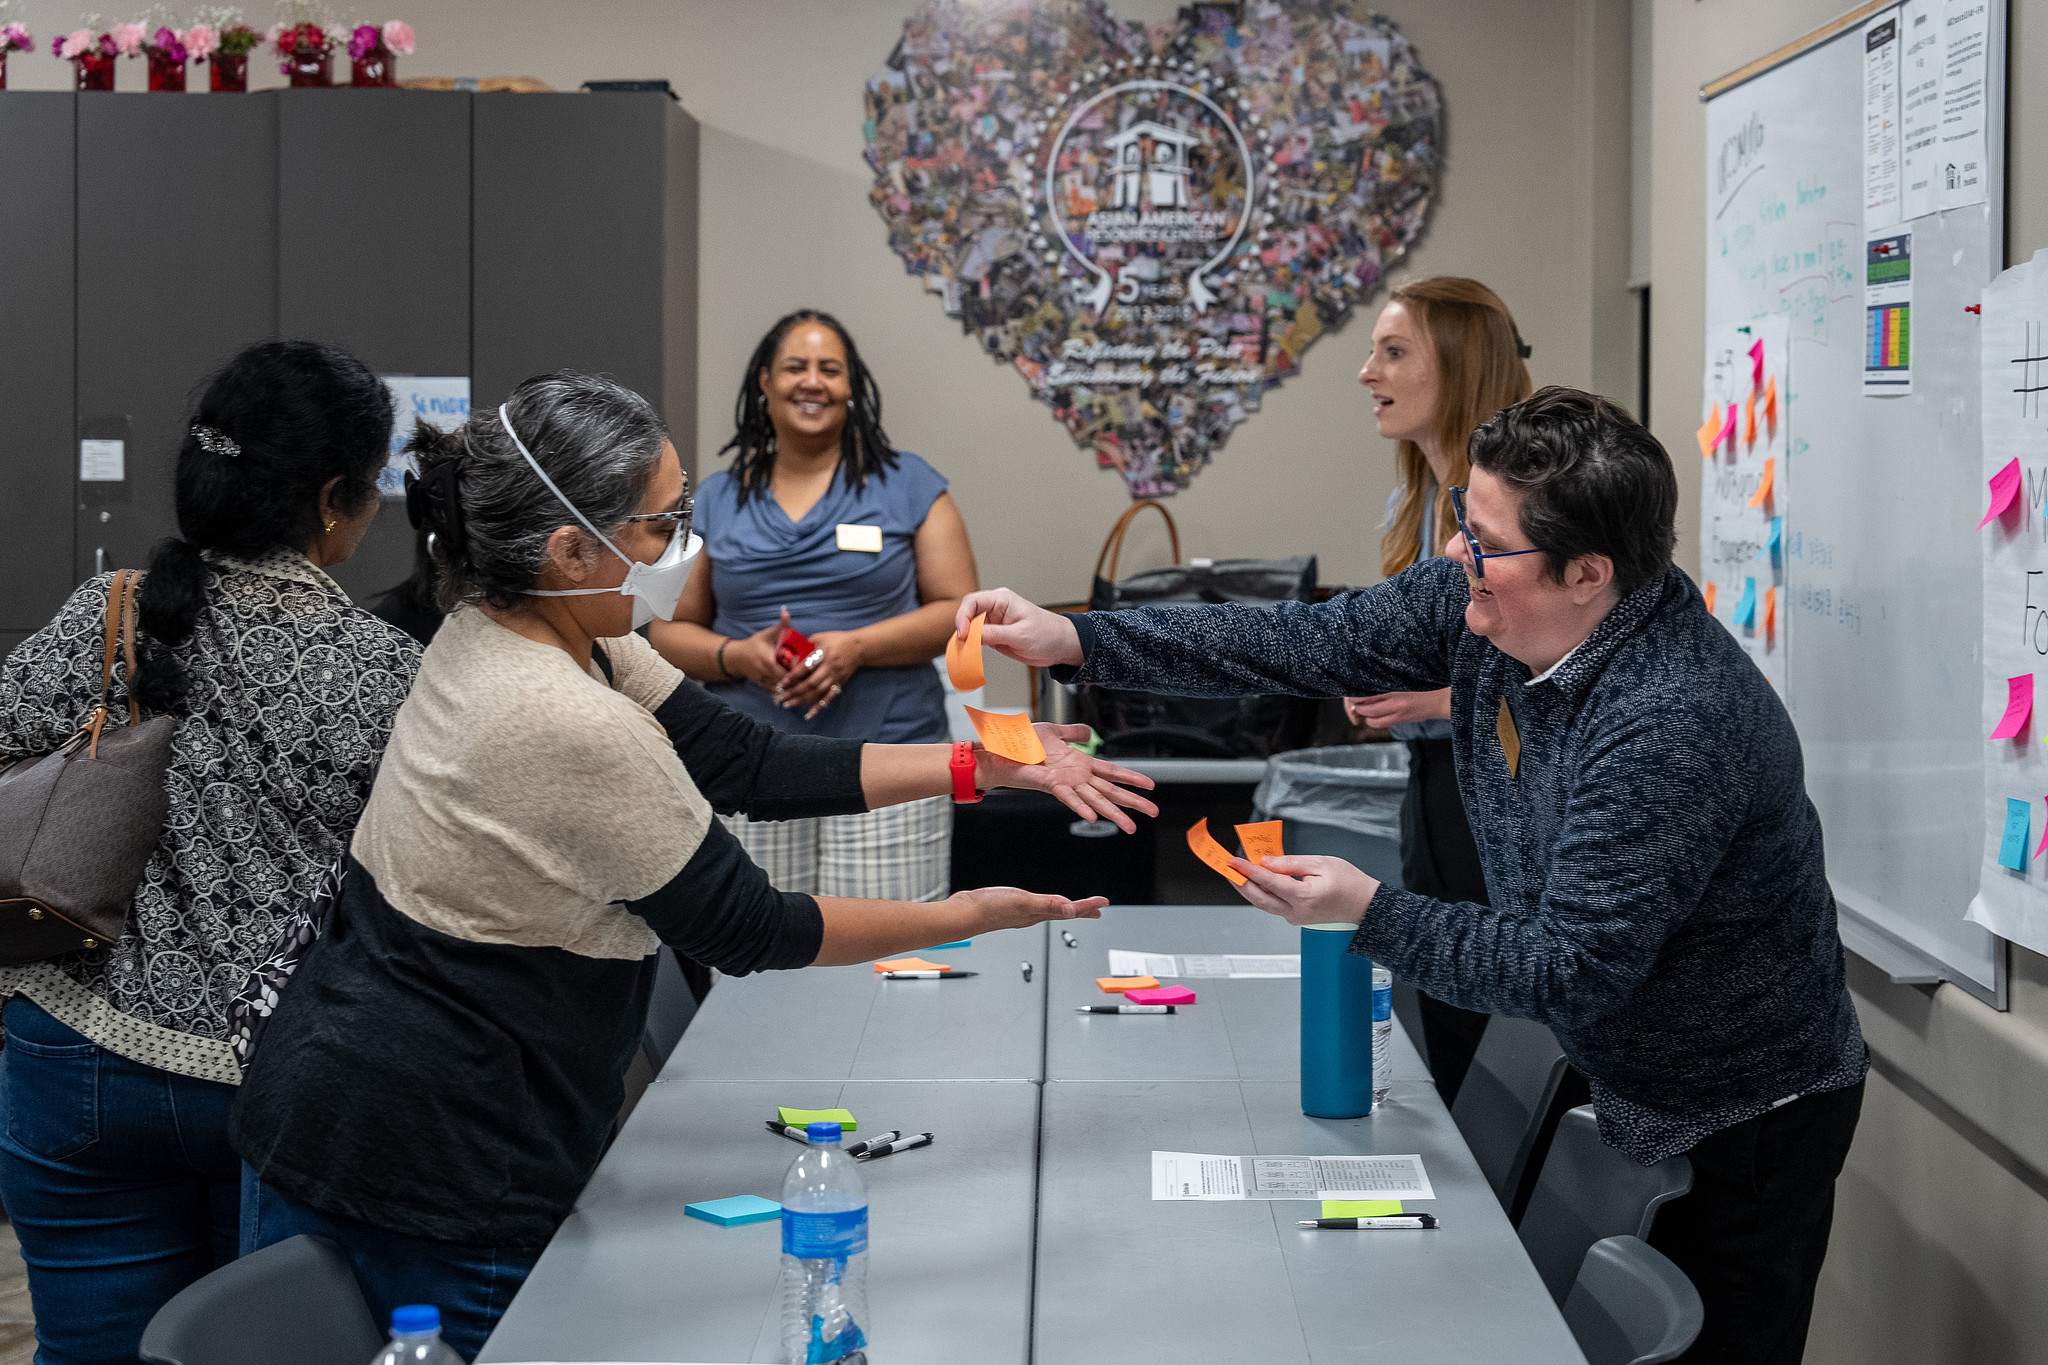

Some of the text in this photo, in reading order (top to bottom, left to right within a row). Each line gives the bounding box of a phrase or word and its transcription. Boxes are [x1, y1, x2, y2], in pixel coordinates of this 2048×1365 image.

[1087, 212, 1227, 226] ASIAN AMERICAN
[1085, 227, 1216, 241] RESOURCE CENTER
[1117, 266, 1139, 302] 5
[1161, 340, 1191, 359] the
[1159, 364, 1189, 384] the
